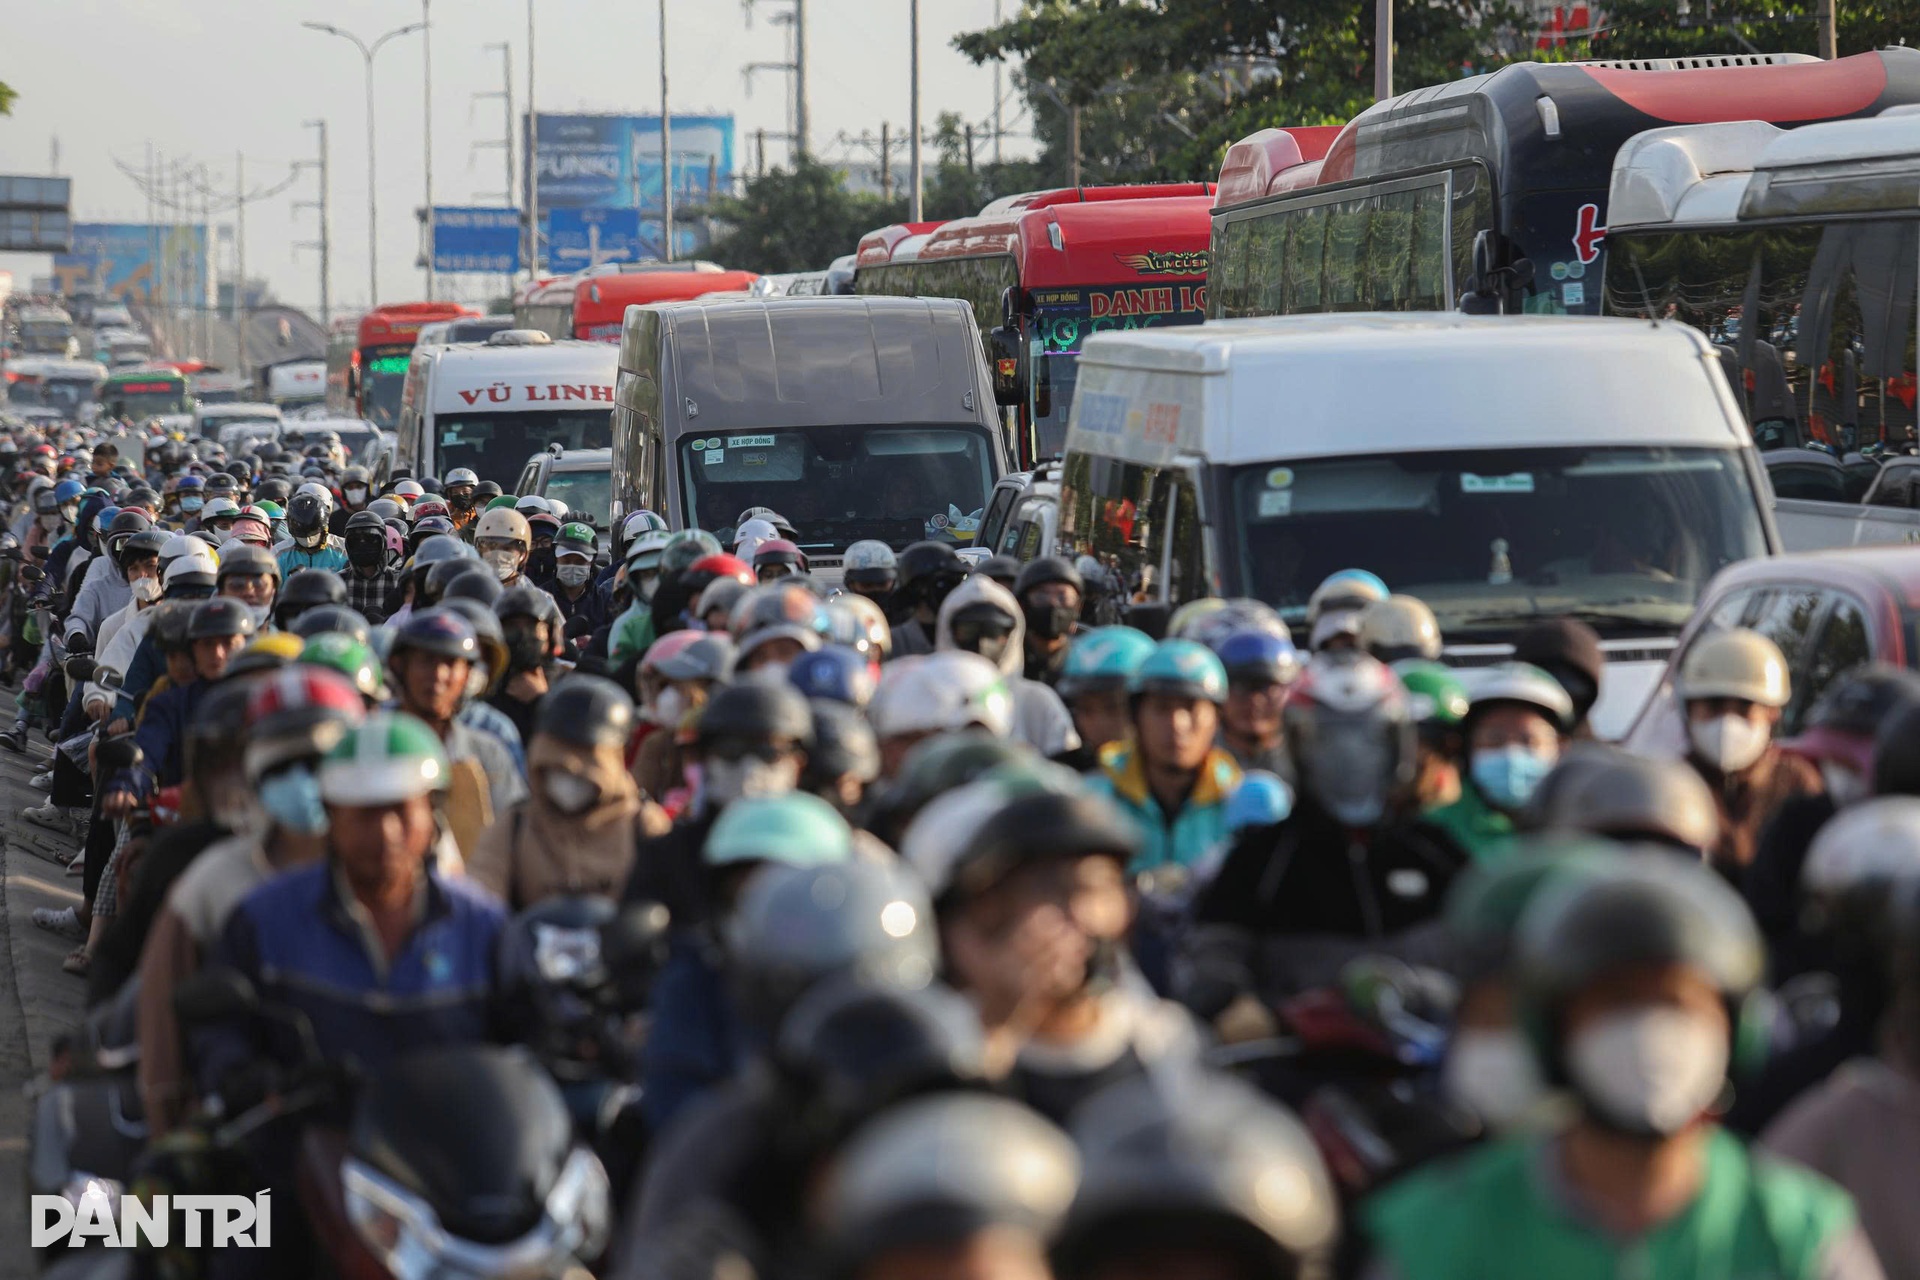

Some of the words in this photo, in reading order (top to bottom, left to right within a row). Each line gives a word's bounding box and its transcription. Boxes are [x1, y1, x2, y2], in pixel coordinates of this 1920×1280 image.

[1089, 287, 1174, 318] DANH
[457, 381, 512, 406] VŨ
[525, 384, 614, 402] LINH
